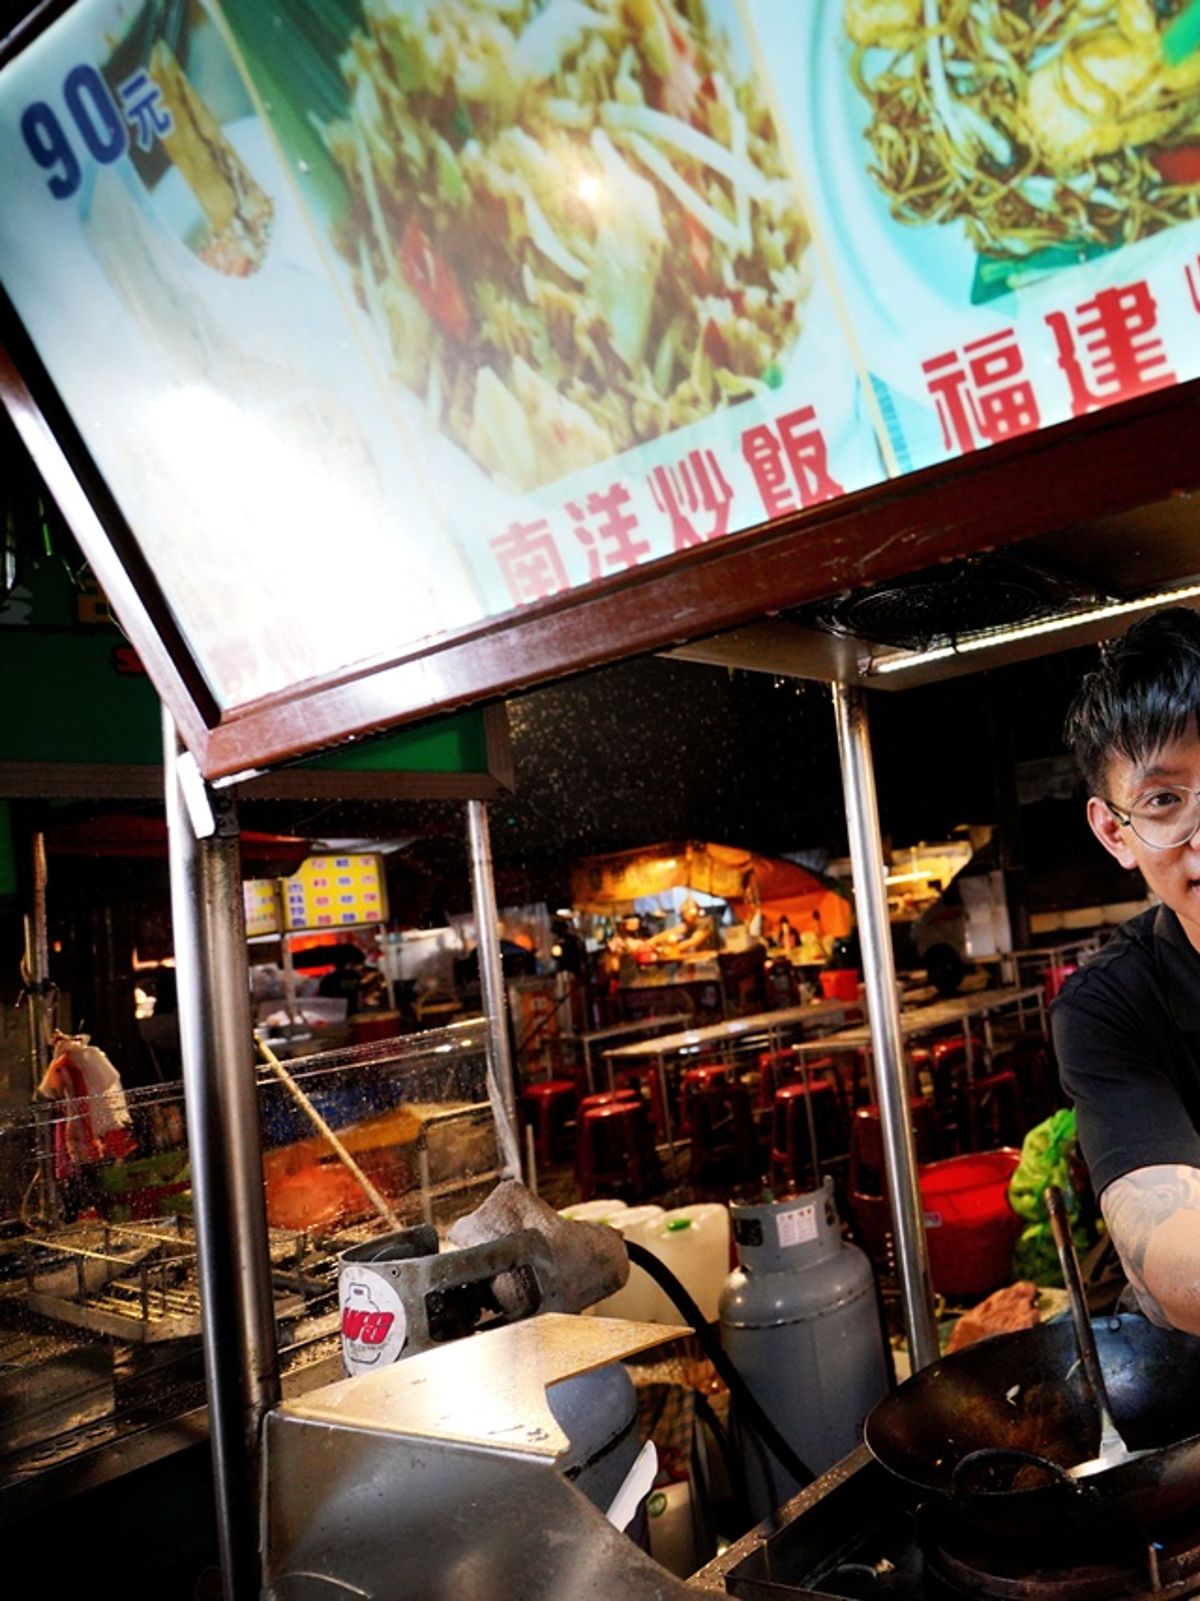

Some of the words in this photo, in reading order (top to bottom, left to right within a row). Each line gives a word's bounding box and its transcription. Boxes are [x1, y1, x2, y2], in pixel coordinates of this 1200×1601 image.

[21, 64, 171, 200] 90元
[488, 404, 845, 609] 南洋炒飯
